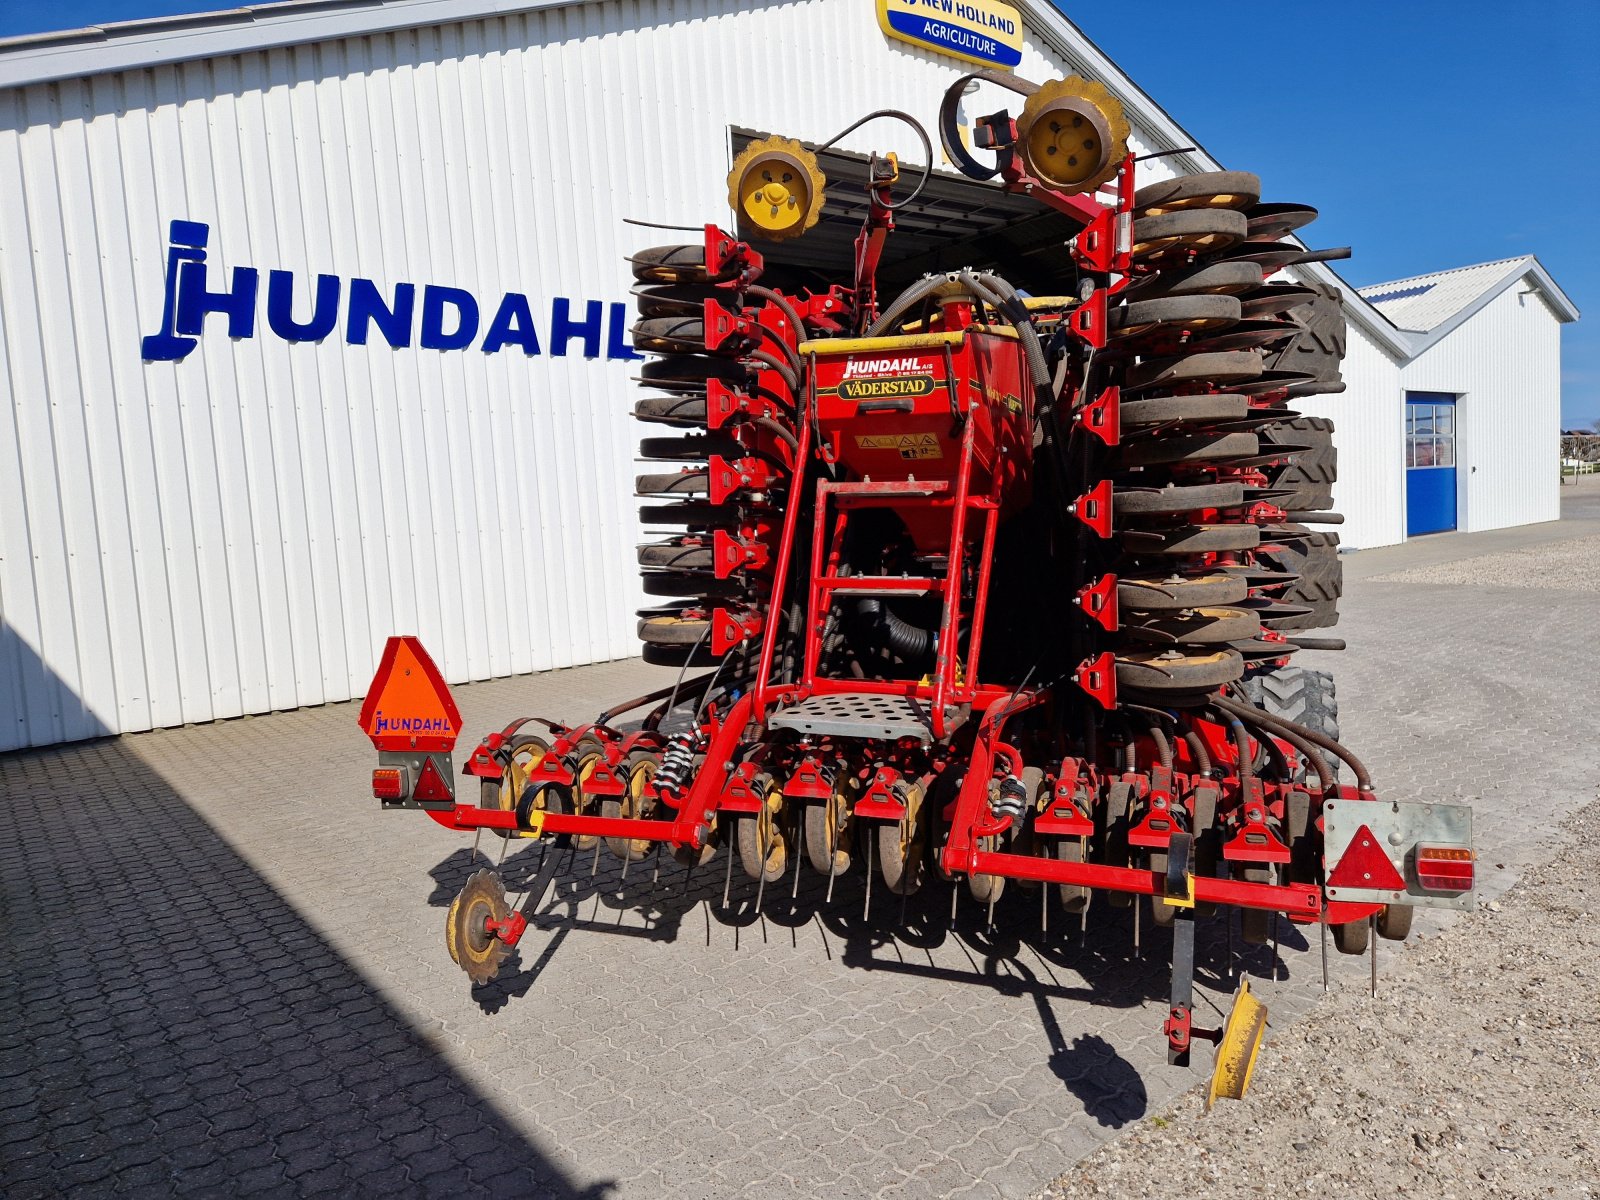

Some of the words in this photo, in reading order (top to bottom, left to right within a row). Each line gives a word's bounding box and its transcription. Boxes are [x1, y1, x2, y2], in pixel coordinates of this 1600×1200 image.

[956, 2, 1015, 36] HOLLAND
[923, 21, 997, 56] AGRICULTURE
[845, 379, 926, 397] VÄDERSTAD
